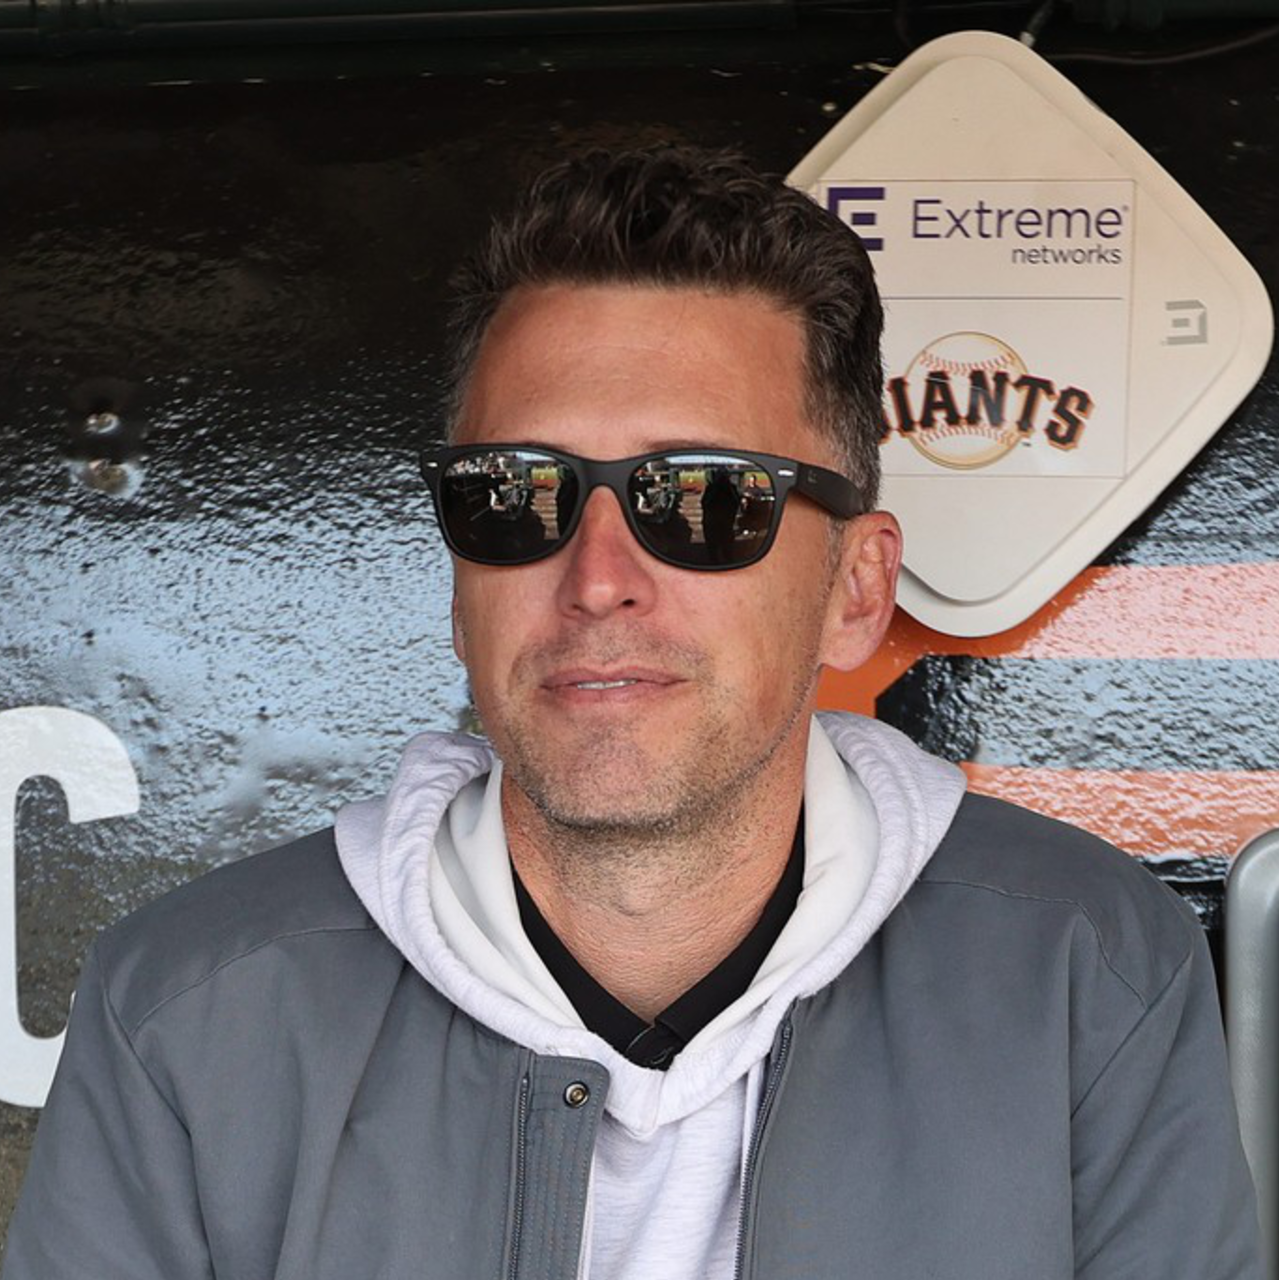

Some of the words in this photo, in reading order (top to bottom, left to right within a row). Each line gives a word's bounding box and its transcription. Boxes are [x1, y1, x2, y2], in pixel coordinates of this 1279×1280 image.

[912, 199, 1122, 239] Extreme
[1012, 246, 1122, 265] networks
[878, 368, 1095, 452] IANTS
